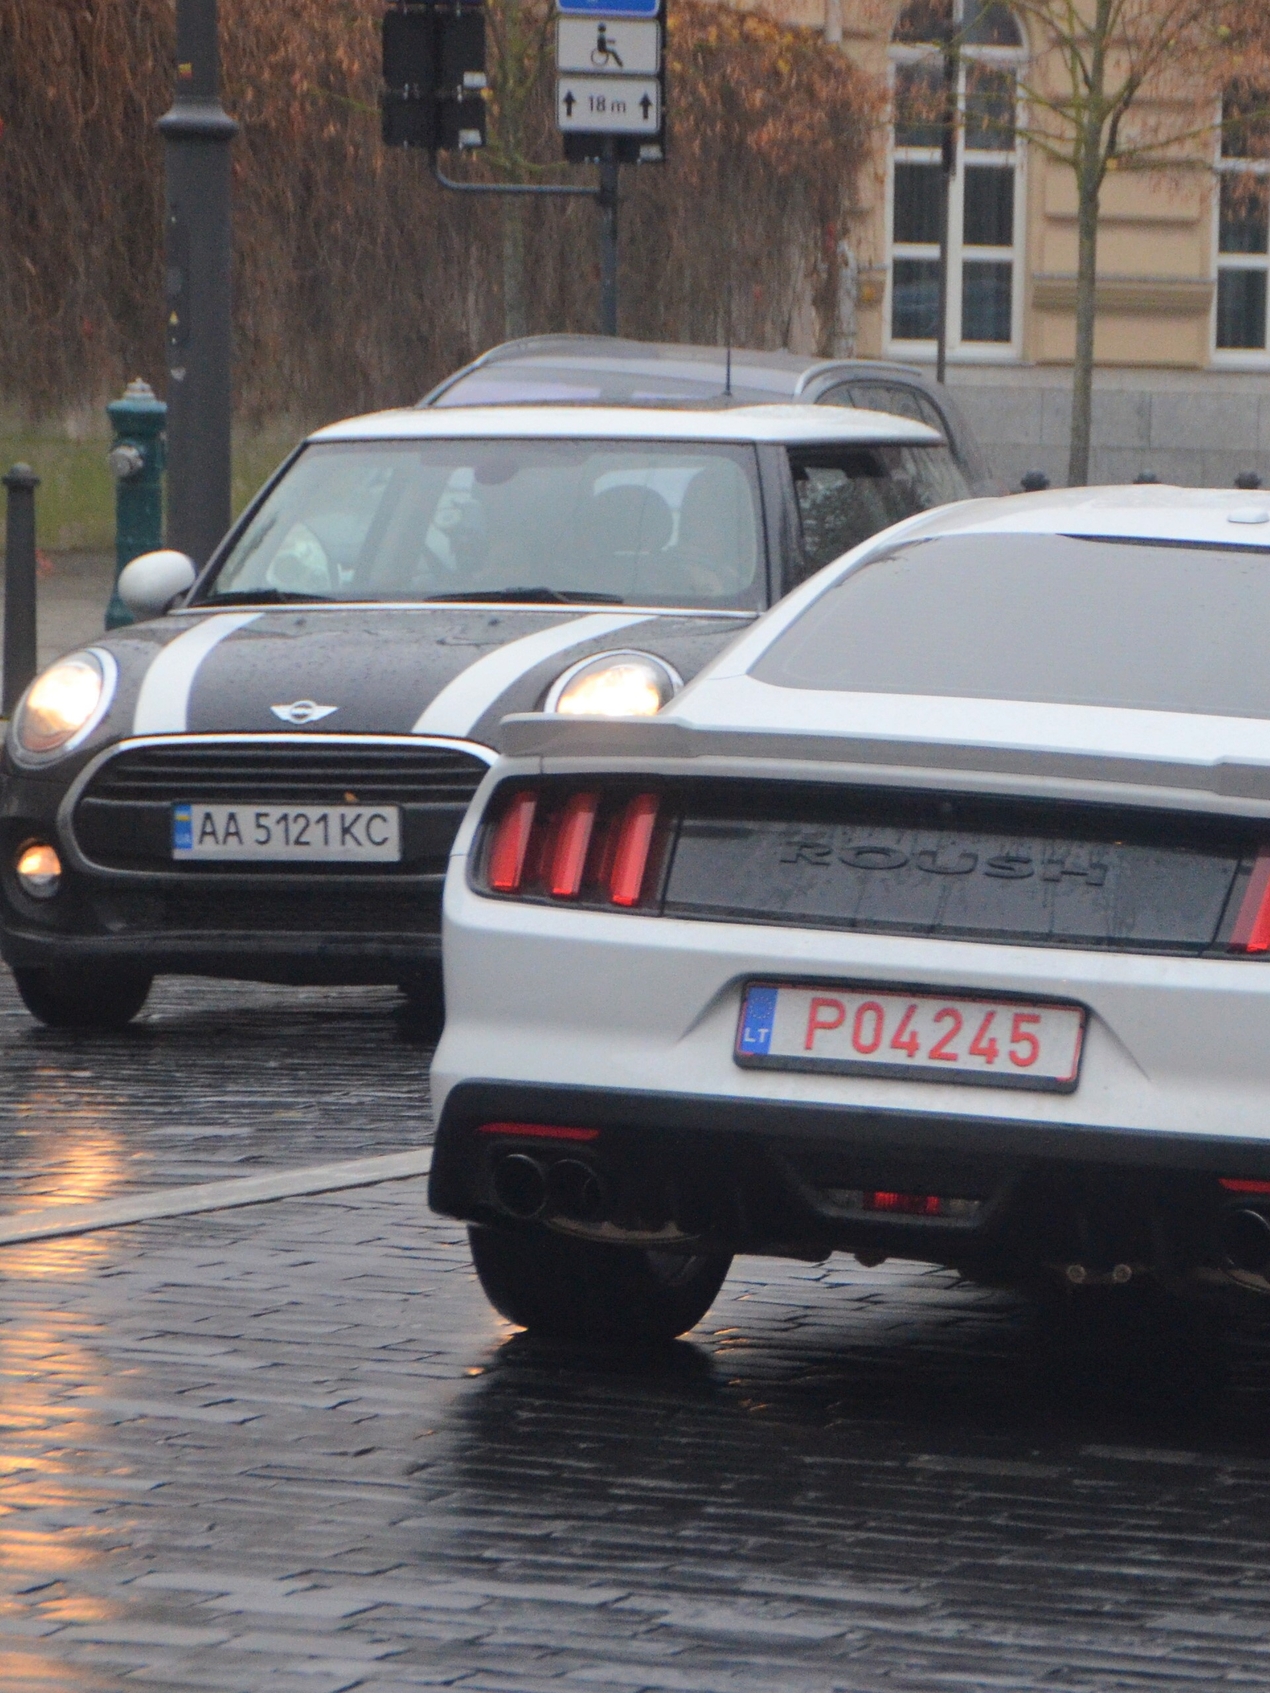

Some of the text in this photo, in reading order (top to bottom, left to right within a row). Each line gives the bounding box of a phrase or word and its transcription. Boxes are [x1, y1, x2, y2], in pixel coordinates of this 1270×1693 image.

[588, 94, 627, 113] 18 m
[198, 811, 390, 847] AA 5121 KC
[779, 840, 1108, 887] ROUSH
[744, 1027, 769, 1044] LT
[803, 996, 1043, 1068] P04245
